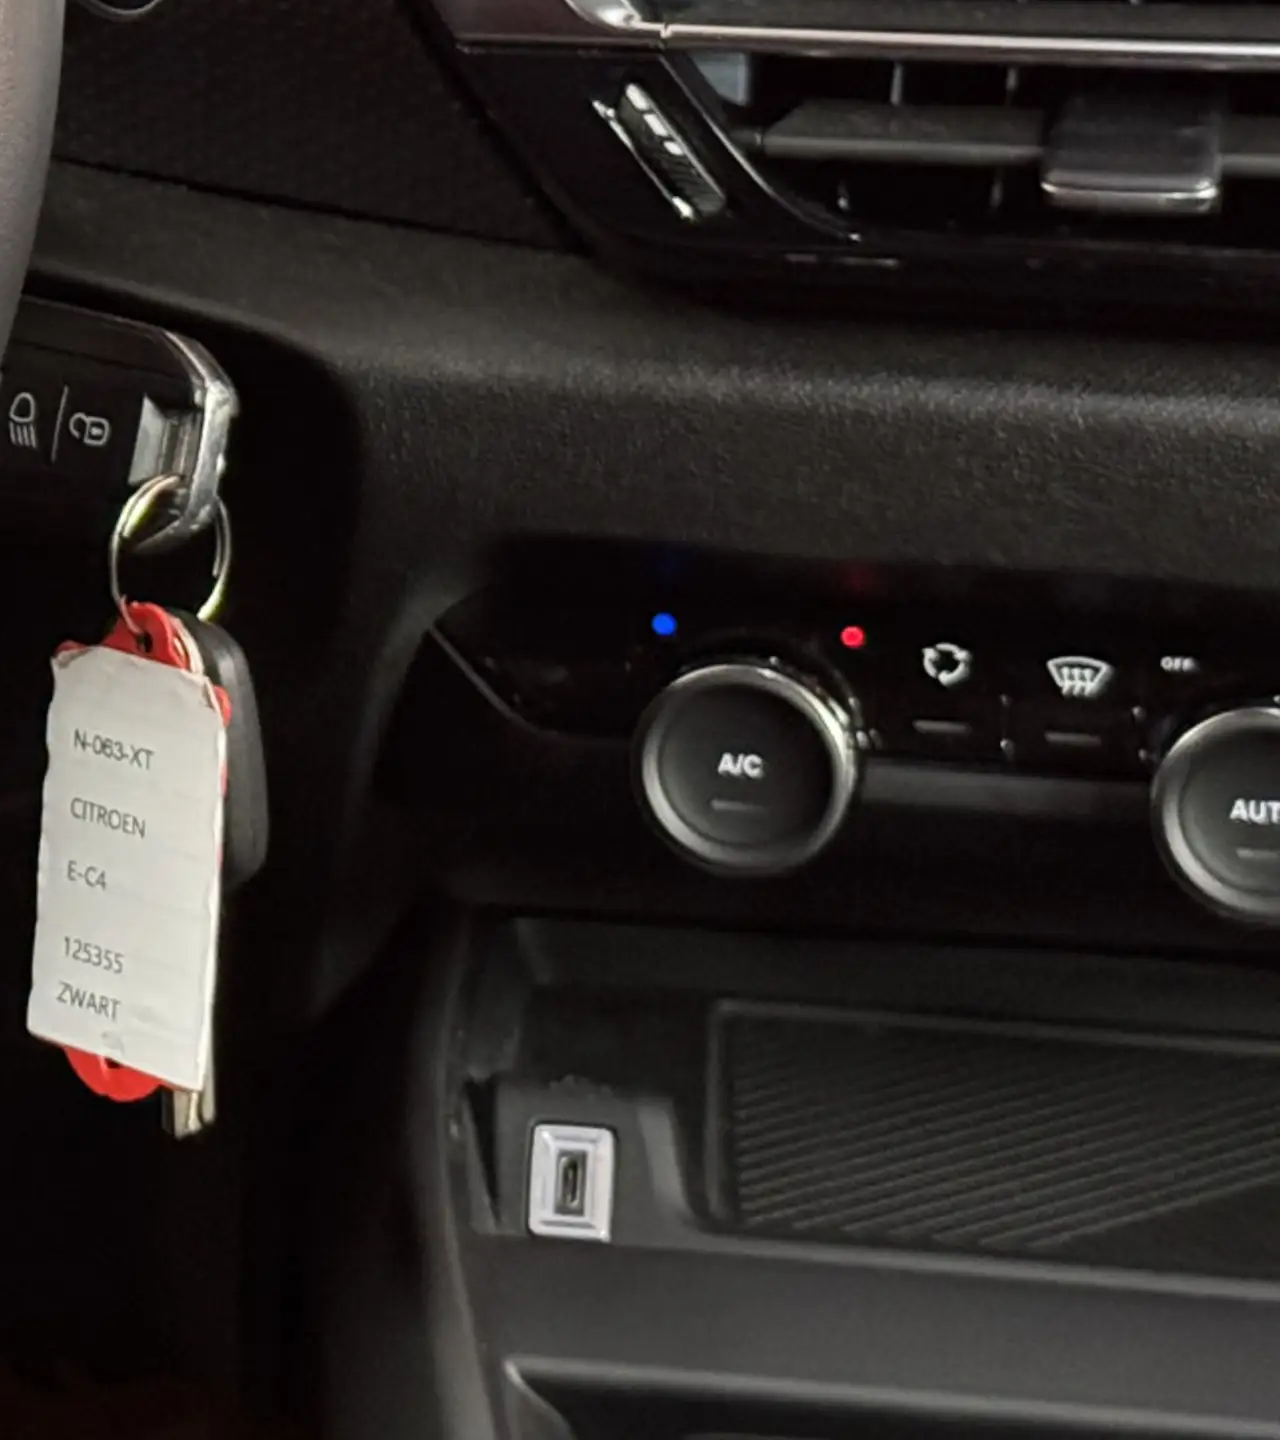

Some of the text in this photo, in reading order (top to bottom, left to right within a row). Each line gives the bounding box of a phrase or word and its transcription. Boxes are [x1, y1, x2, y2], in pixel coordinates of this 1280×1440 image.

[1159, 656, 1199, 672] OFF
[73, 728, 155, 771] N-063-XT
[717, 752, 764, 779] A/C
[69, 796, 146, 840] CITROEN
[66, 859, 108, 892] E-C4
[63, 935, 125, 975] 125355
[55, 979, 123, 1023] ZWART
